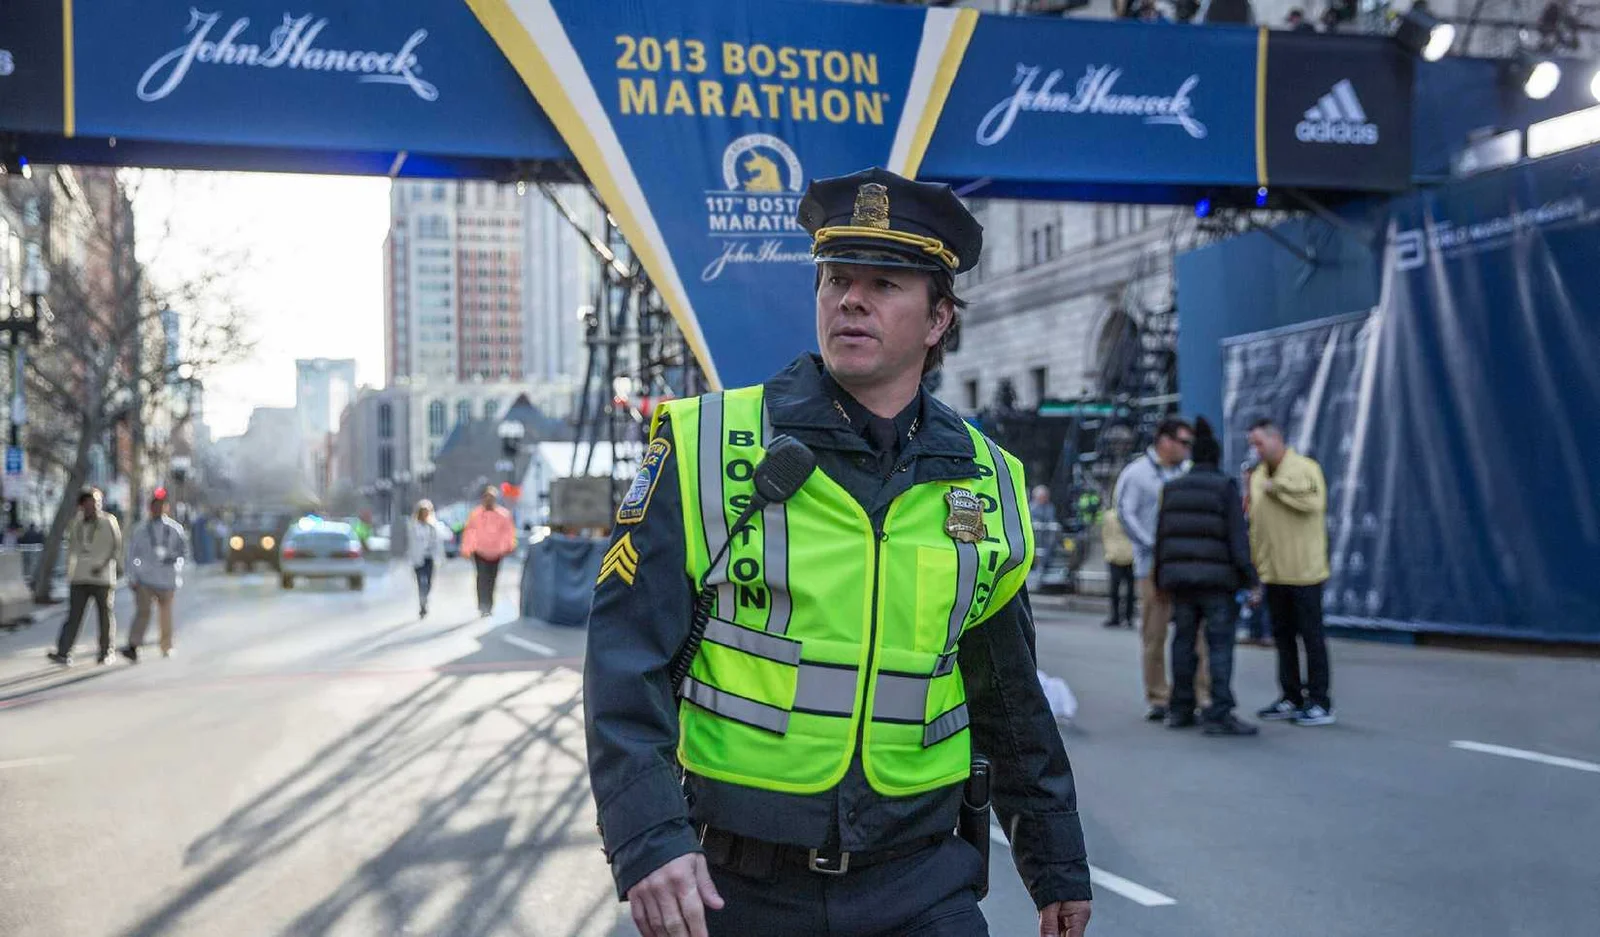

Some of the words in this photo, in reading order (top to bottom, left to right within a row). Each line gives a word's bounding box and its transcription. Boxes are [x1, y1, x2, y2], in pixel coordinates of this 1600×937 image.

[136, 6, 262, 102] John
[258, 11, 439, 102] Hancock
[615, 34, 708, 74] 2013
[722, 41, 880, 85] BOSTON
[617, 77, 885, 125] MARATHON
[976, 62, 1072, 146] John
[1068, 62, 1208, 140] Hancock
[1295, 119, 1379, 144] adidas
[709, 214, 799, 231] MARATH
[747, 197, 801, 213] BOST
[701, 239, 756, 282] John
